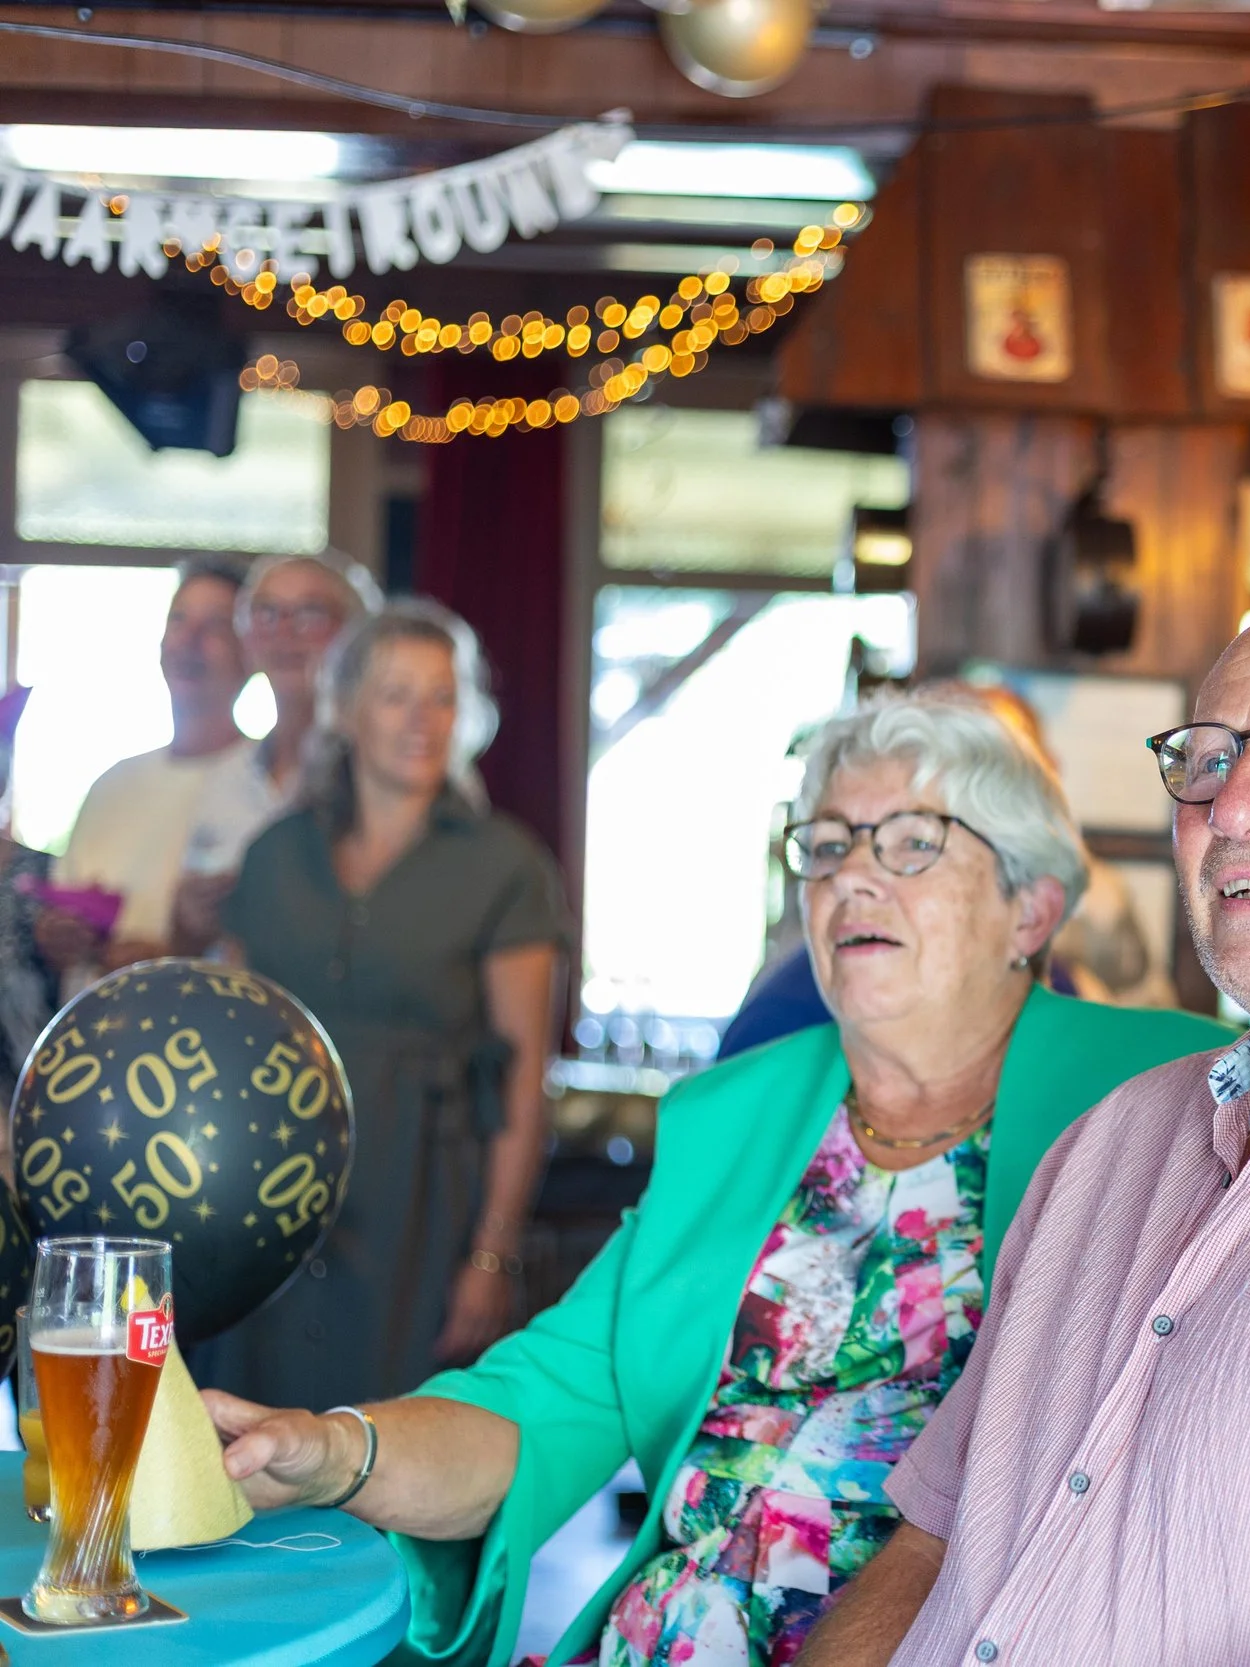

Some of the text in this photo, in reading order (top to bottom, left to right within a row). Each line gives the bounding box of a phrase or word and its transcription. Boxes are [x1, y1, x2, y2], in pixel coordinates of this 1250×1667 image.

[35, 1027, 101, 1104] 50
[126, 1028, 218, 1119] 50
[251, 1041, 329, 1120] 50
[22, 1137, 90, 1222] 50
[111, 1131, 202, 1230] 50
[258, 1153, 329, 1237] 50
